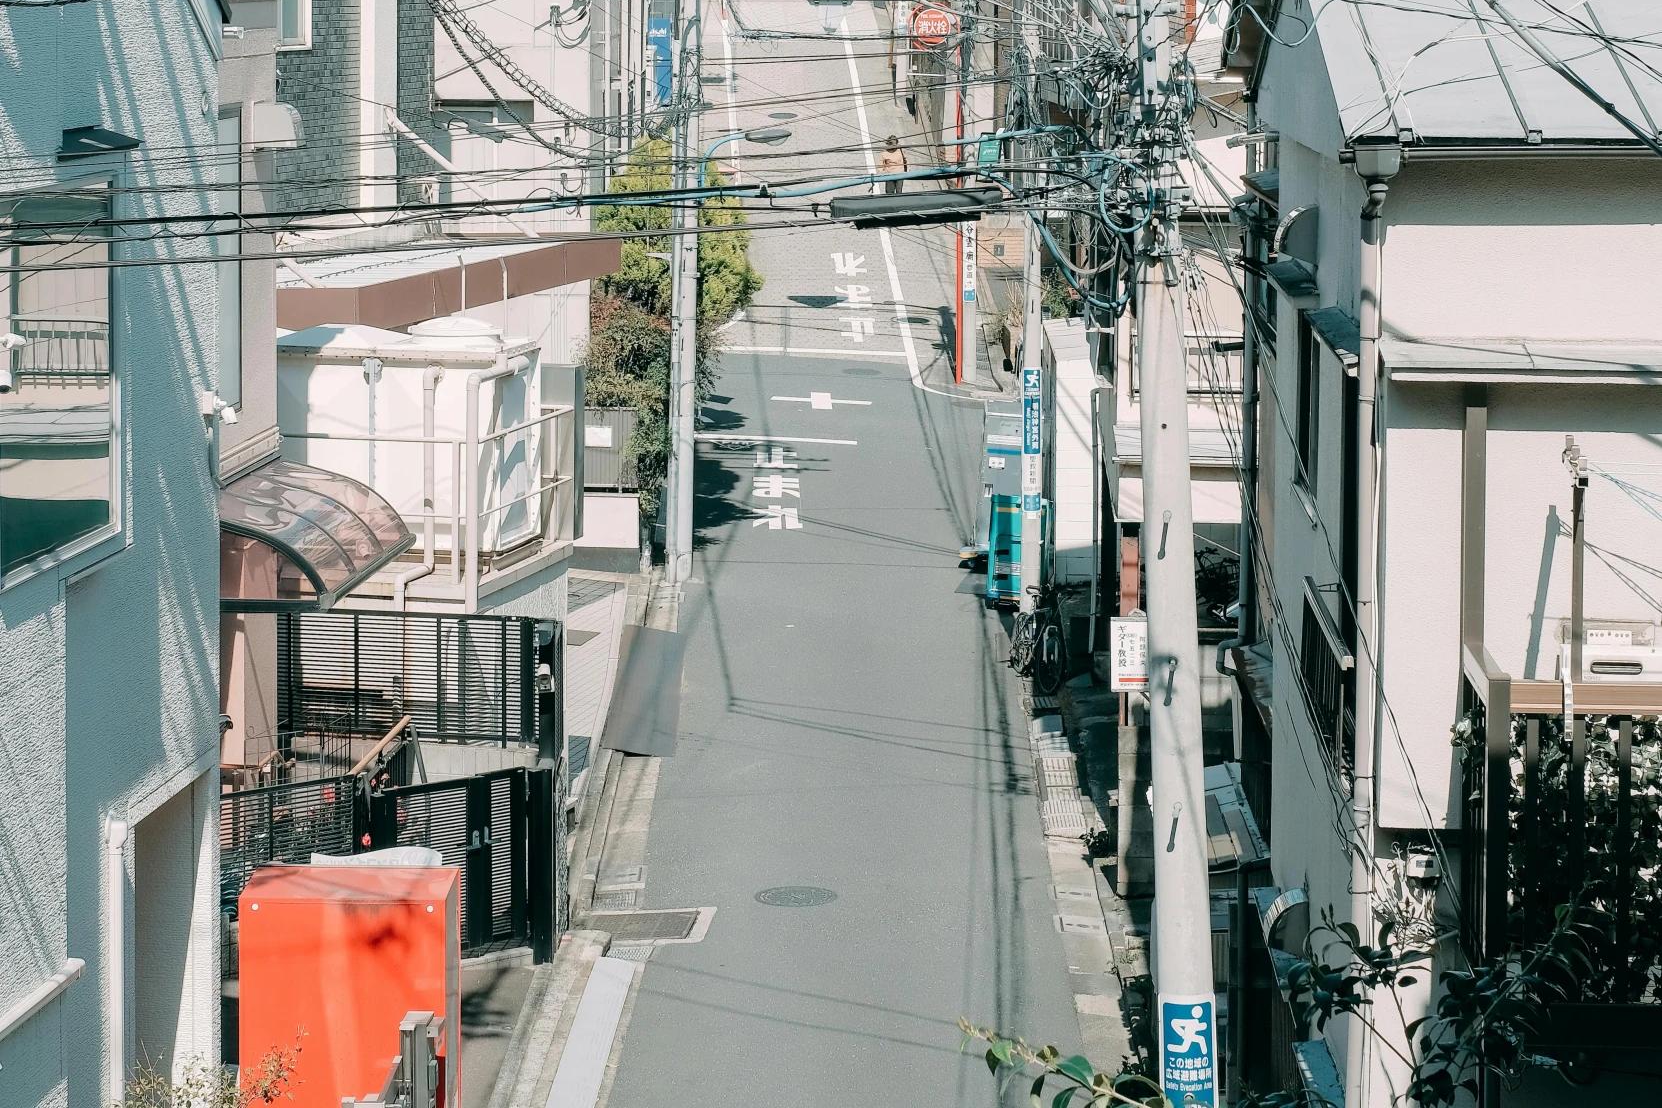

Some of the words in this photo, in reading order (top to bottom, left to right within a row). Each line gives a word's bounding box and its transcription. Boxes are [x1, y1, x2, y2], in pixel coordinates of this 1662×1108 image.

[918, 20, 948, 35] 消火栓
[1029, 455, 1037, 485] 聖教新聞
[752, 447, 804, 530] 止まれ
[1117, 625, 1127, 668] ギター教授
[1169, 1056, 1209, 1069] この地域の
[1166, 1067, 1212, 1081] 広域避難場所
[1166, 1081, 1178, 1090] Safety
[1204, 1082, 1212, 1090] Area
